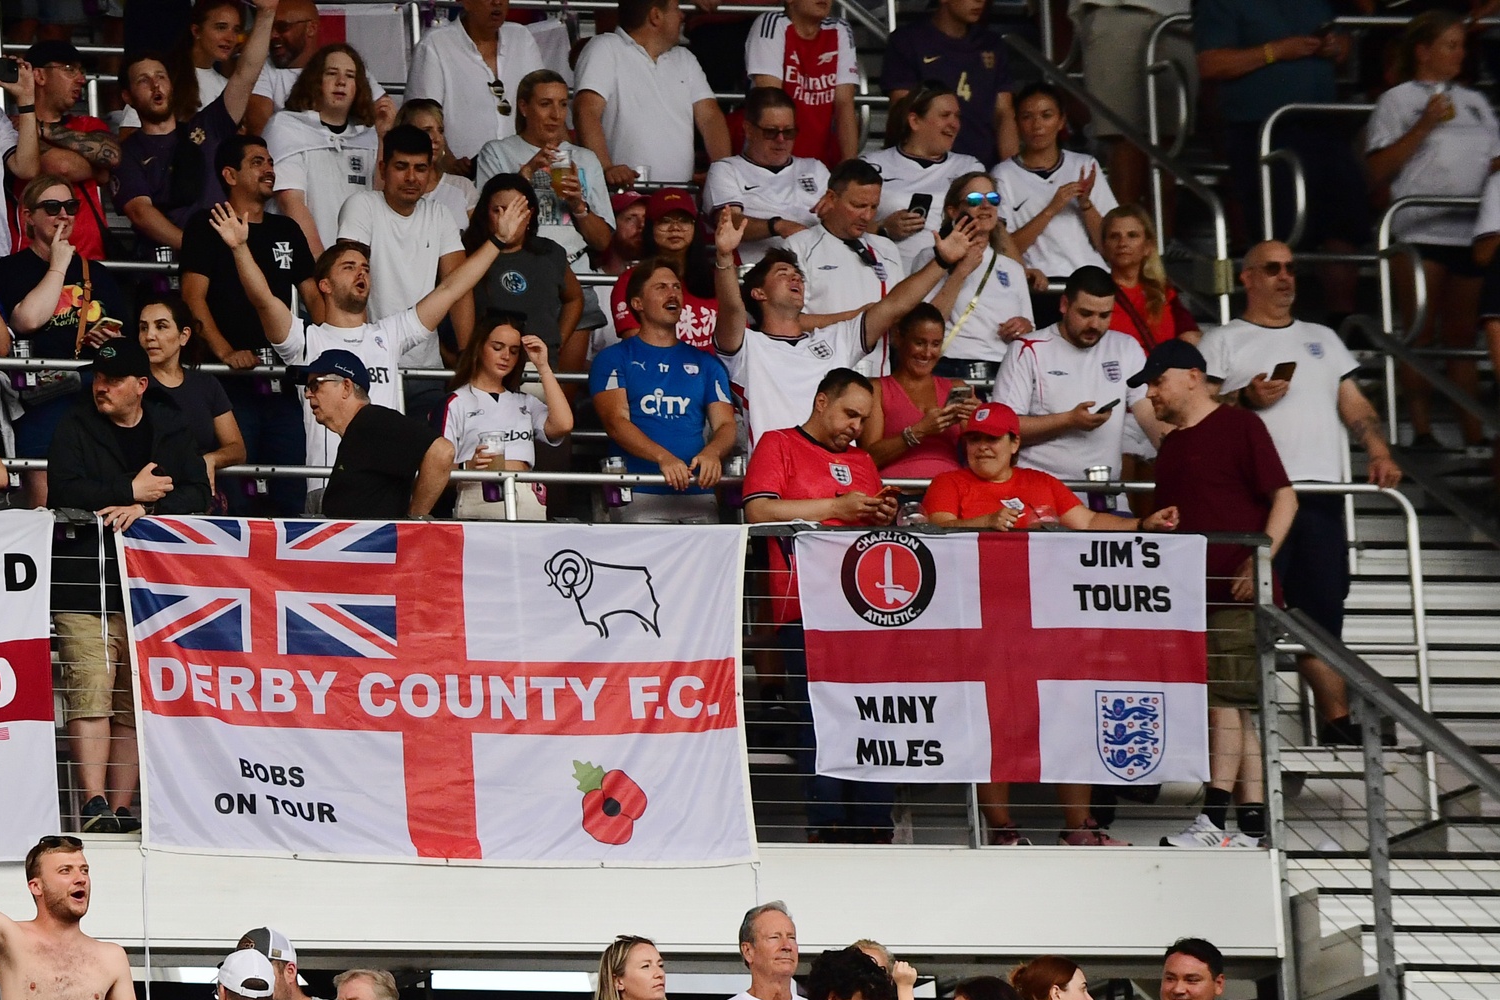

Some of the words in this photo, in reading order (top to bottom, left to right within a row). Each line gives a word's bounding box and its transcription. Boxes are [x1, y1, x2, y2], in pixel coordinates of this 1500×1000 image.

[957, 72, 972, 101] 4
[367, 366, 390, 384] BET
[658, 362, 670, 373] 17
[855, 531, 920, 552] CHARLTON
[1080, 536, 1161, 569] JIM'S
[1073, 584, 1172, 613] TOURS
[863, 606, 917, 626] ATHLETIC
[147, 656, 337, 715] DERBY
[358, 671, 608, 722] COUNTY
[628, 675, 720, 720] F.C.
[854, 696, 937, 724] MANY
[856, 739, 944, 768] MILES
[239, 758, 306, 788] BOBS
[214, 793, 258, 815] ON
[266, 795, 338, 824] TOUR
